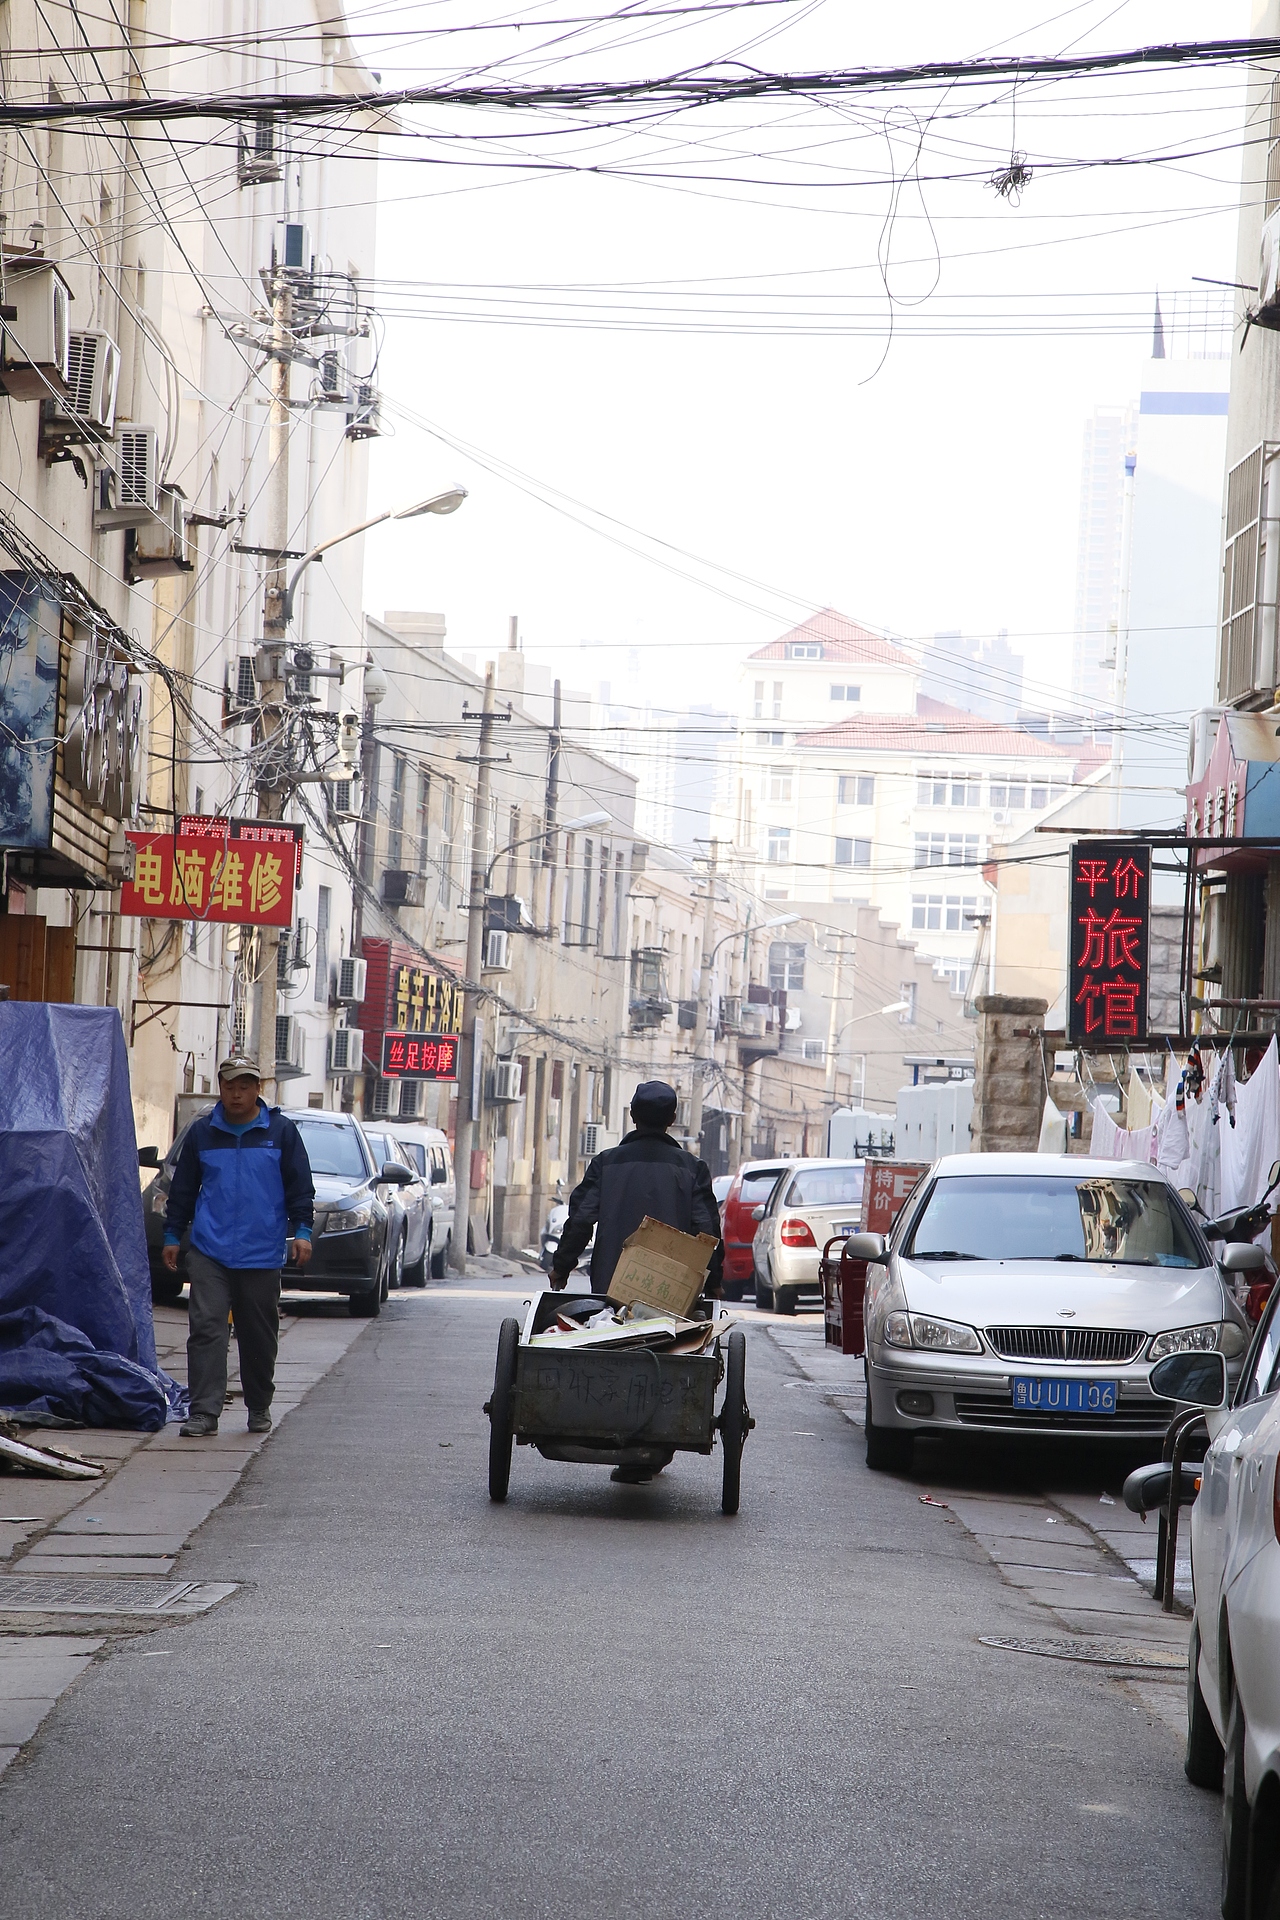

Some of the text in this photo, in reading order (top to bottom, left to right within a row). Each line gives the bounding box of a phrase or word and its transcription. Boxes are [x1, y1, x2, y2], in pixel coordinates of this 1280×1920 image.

[134, 845, 284, 914] 电脑维修
[1076, 857, 1144, 899] 平价
[1075, 907, 1143, 1036] 旅馆
[388, 1040, 453, 1072] 丝足按摩
[873, 1169, 893, 1211] 特价
[625, 1267, 672, 1300] 小烧锅
